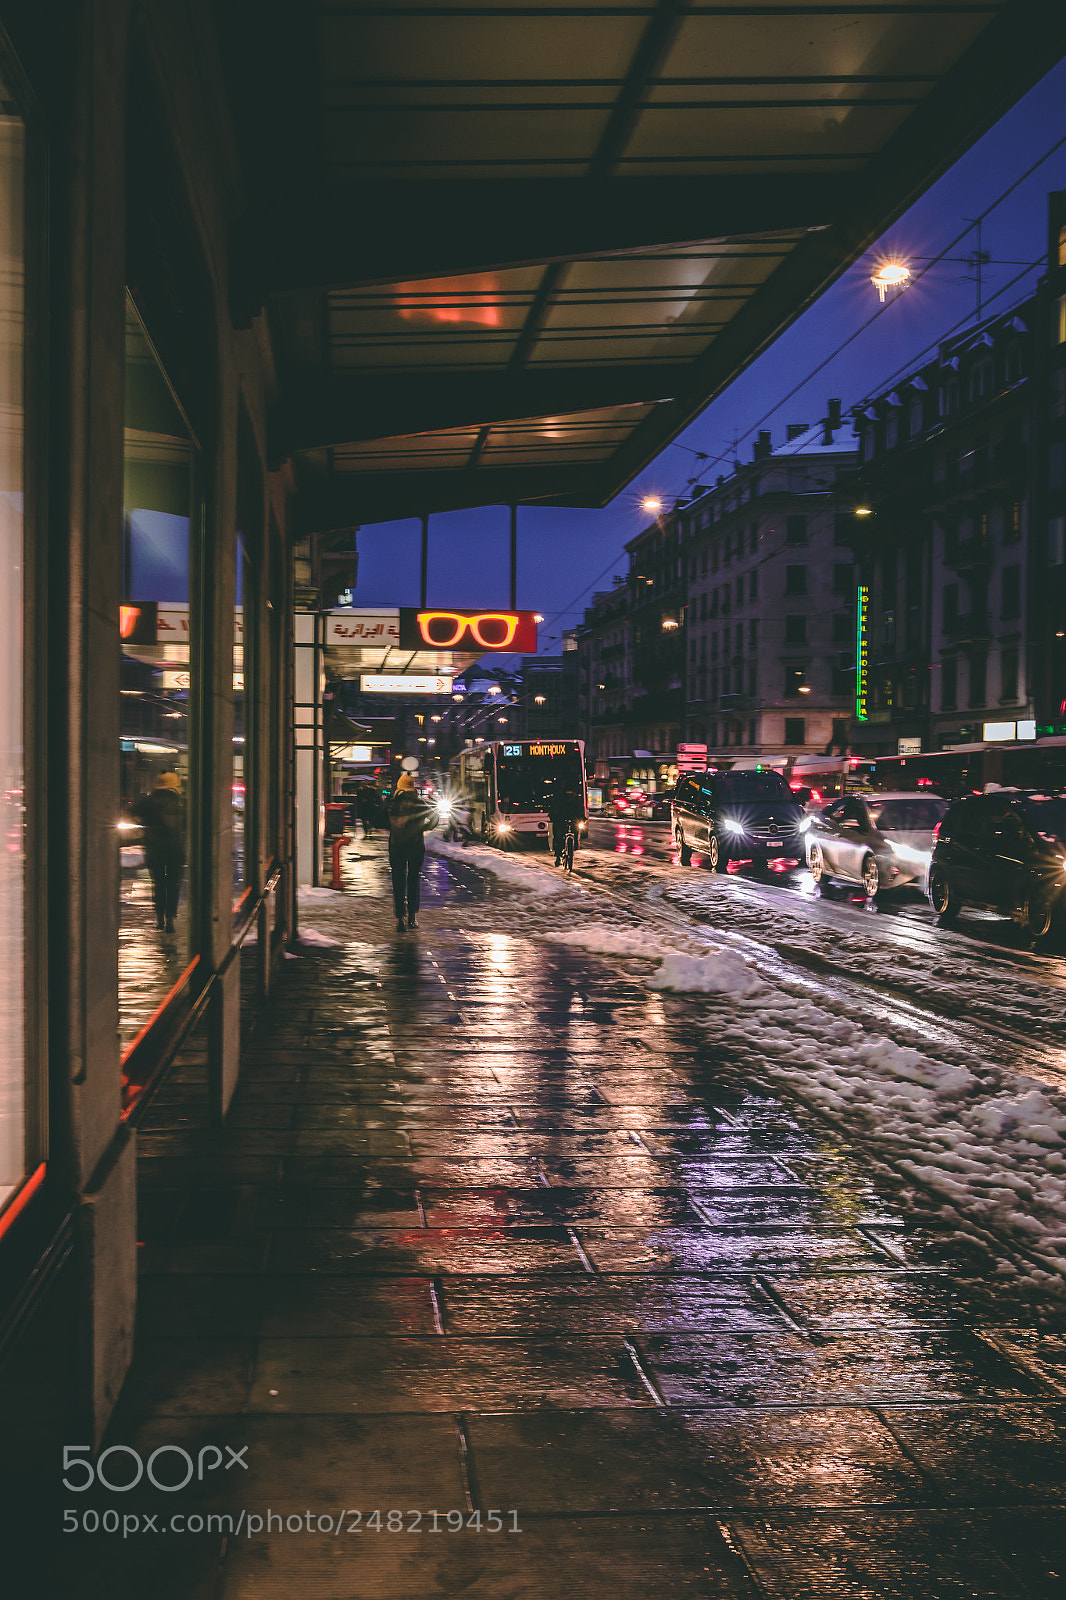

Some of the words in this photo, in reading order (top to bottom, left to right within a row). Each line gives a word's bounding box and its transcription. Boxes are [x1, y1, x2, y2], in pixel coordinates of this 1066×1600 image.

[860, 586, 869, 632] HOTEL
[860, 640, 868, 715] RHODANIA
[505, 745, 520, 756] 25
[529, 744, 566, 756] MONTHOUX
